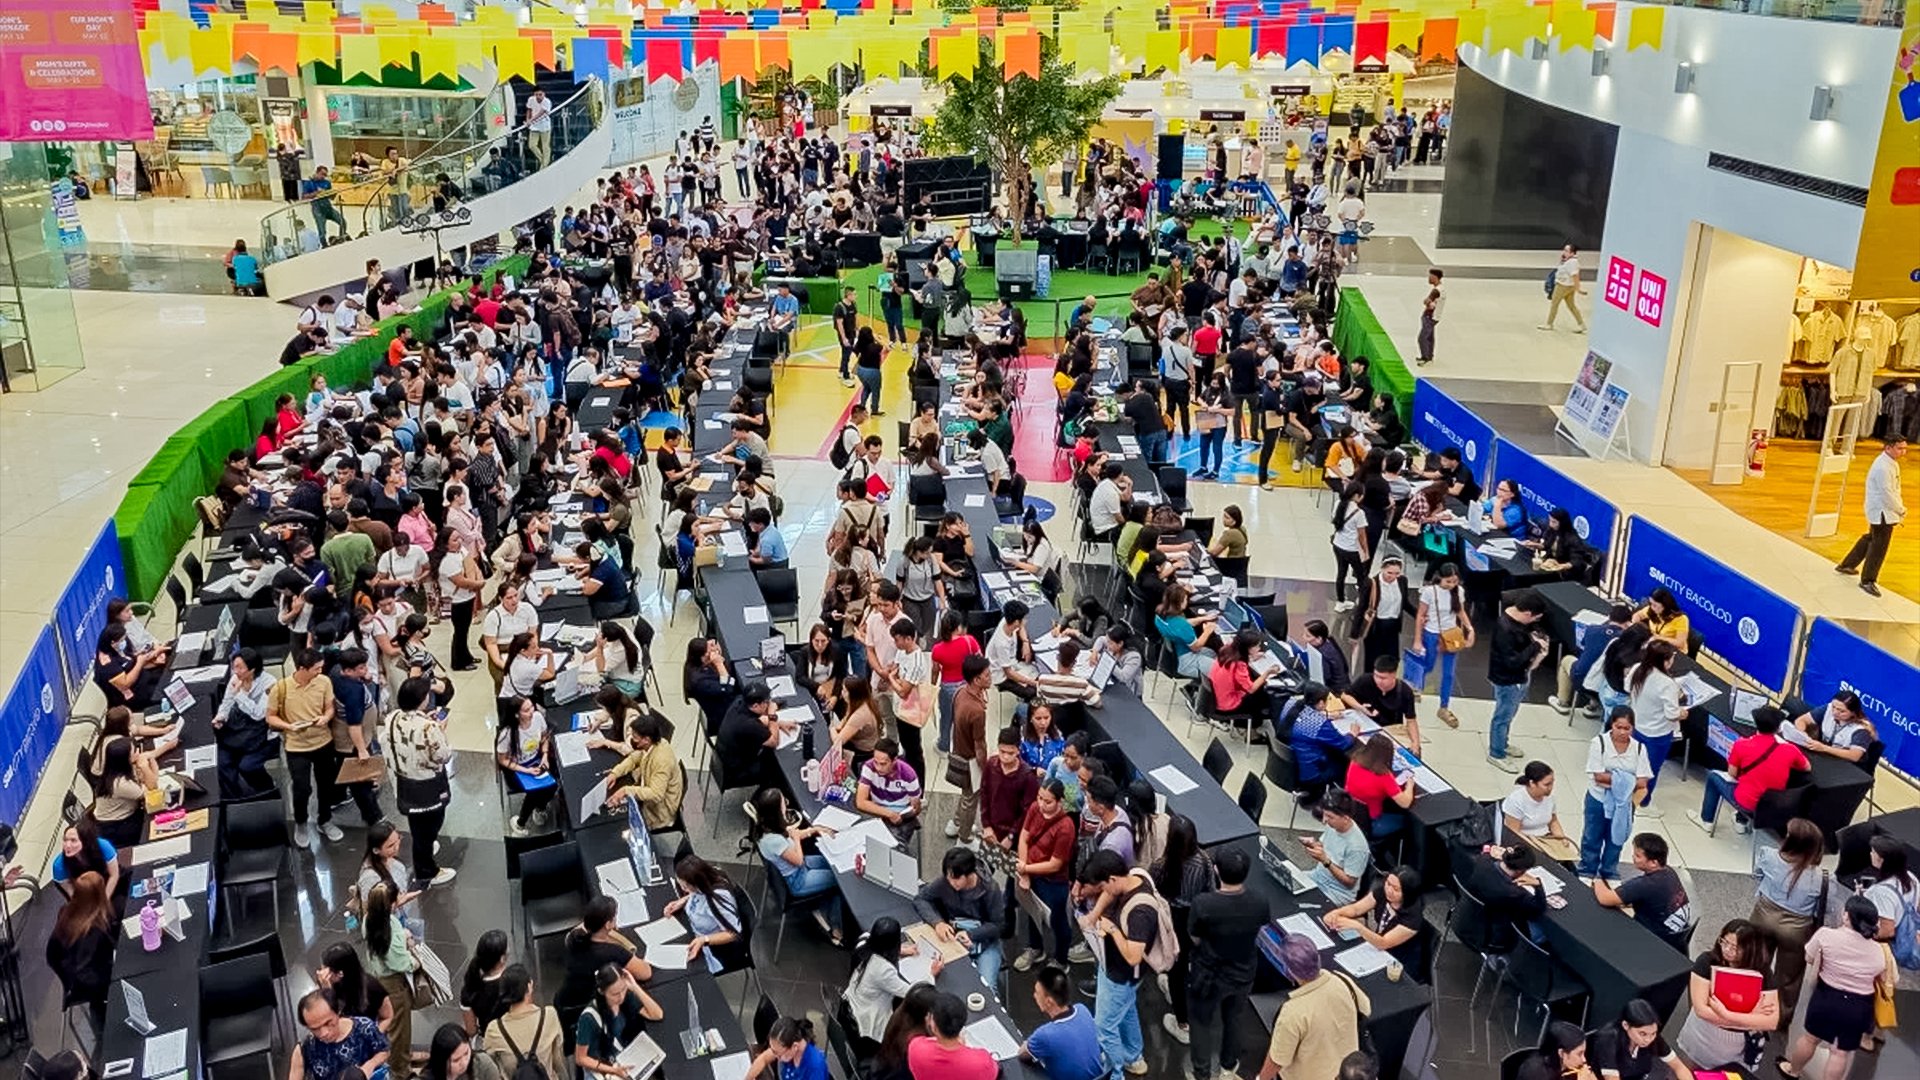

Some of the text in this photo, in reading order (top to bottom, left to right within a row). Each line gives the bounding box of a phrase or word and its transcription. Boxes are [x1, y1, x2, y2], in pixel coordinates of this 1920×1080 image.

[0, 16, 22, 24] OM'S
[35, 60, 63, 68] MOM'S
[37, 68, 97, 77] CELEBRATIONS
[1641, 277, 1662, 301] UNI
[1637, 296, 1660, 320] QLO
[1521, 486, 1537, 502] CITY
[1648, 566, 1732, 624] SM CITY BACOLOD
[1860, 693, 1892, 718] CITY
[1891, 710, 1920, 737] BAC
